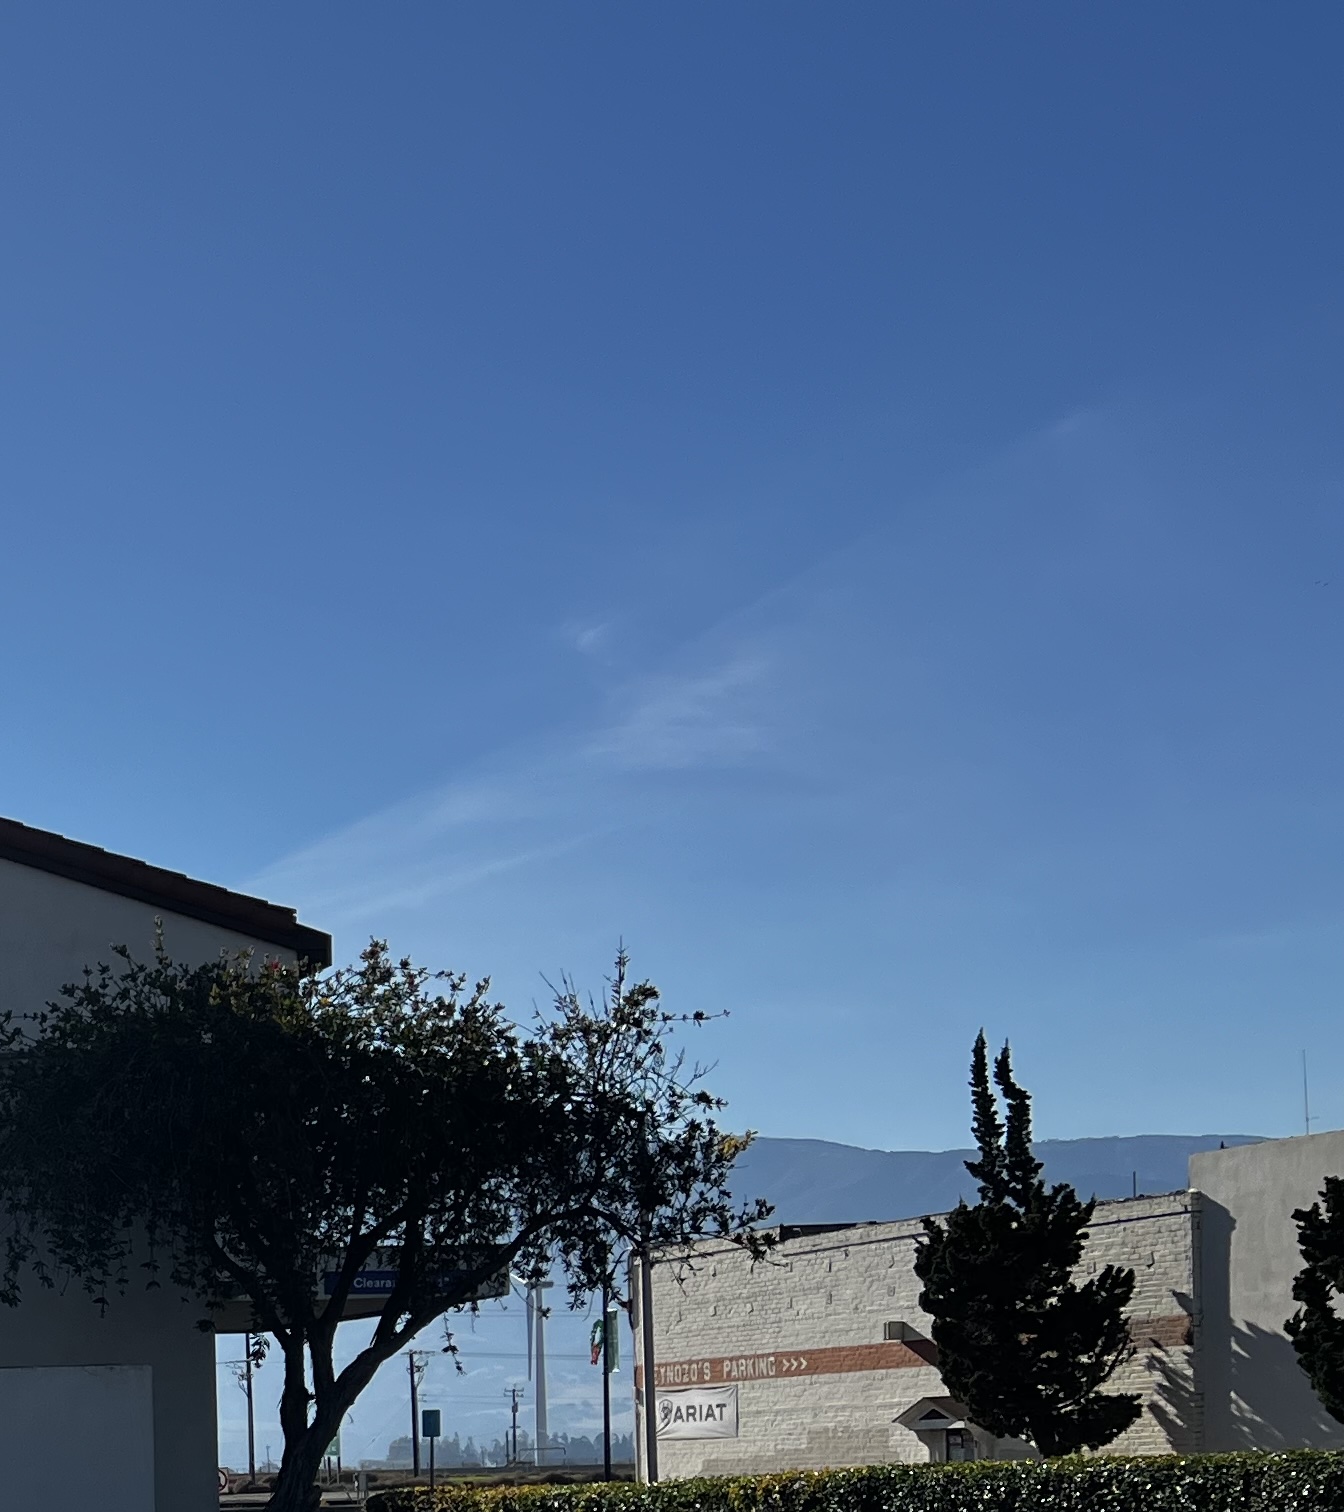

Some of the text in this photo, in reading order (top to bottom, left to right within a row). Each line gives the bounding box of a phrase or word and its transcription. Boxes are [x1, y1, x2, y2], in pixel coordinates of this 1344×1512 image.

[353, 1277, 396, 1289] Cleara
[654, 1356, 777, 1386] EYNOZO'S PARKING
[672, 1403, 727, 1423] ARIAT
